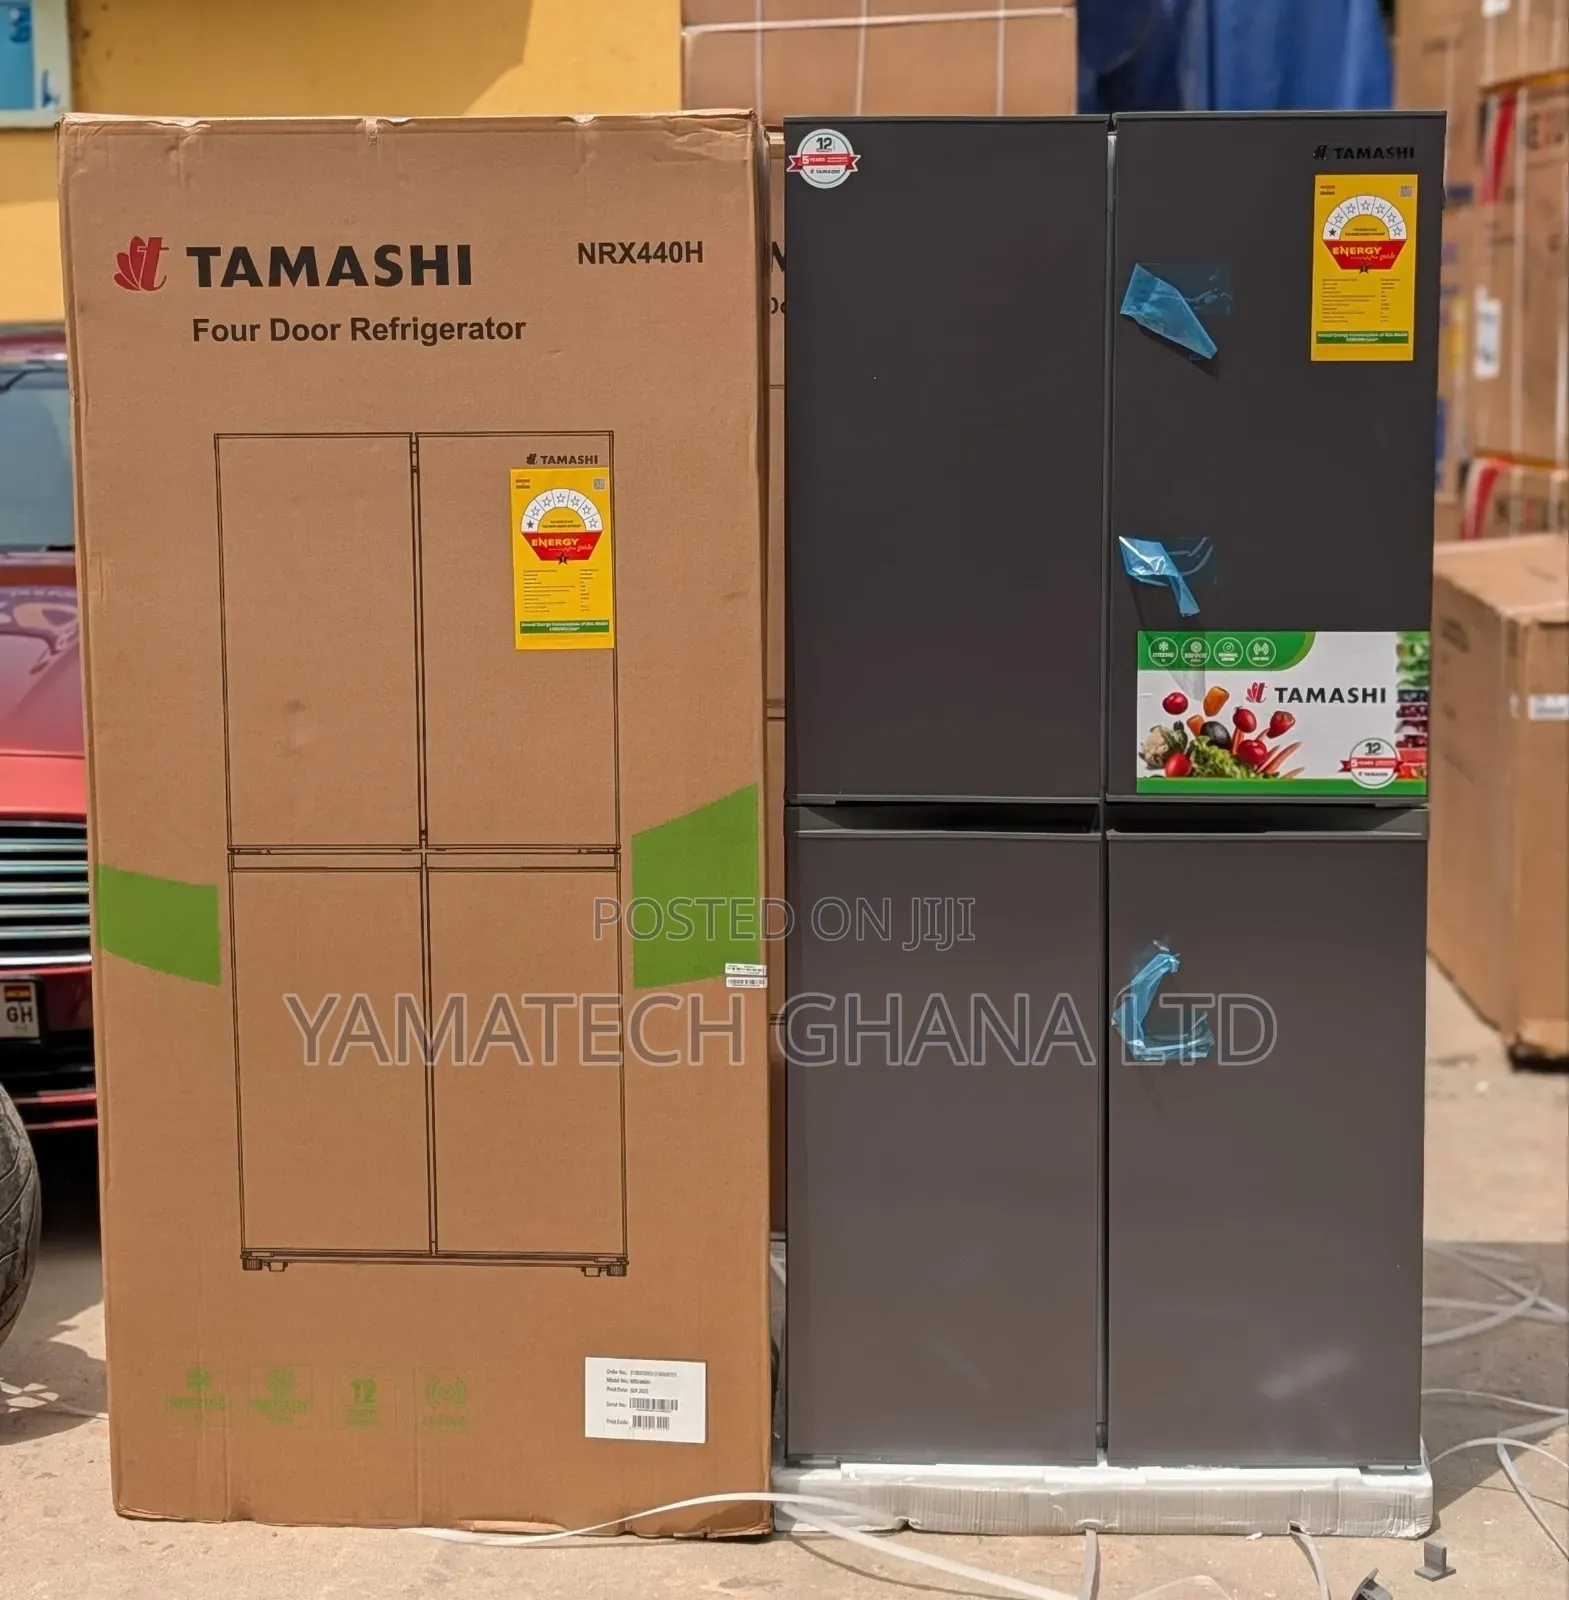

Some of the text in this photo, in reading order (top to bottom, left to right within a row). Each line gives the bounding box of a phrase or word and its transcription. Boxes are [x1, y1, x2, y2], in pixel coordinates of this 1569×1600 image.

[816, 138, 832, 149] 12
[1334, 146, 1415, 160] TAMASHI
[802, 156, 809, 164] 5
[577, 241, 703, 264] NRX440H
[1332, 246, 1382, 256] ENERGY
[186, 244, 472, 287] TAMASHI
[193, 317, 526, 346] Four Door Refrigerator
[540, 455, 599, 465] TAMASHI
[532, 538, 579, 548] ENERGY
[1274, 687, 1386, 703] TAMASHI
[1365, 742, 1381, 754] 12
[7, 1006, 33, 1023] GH
